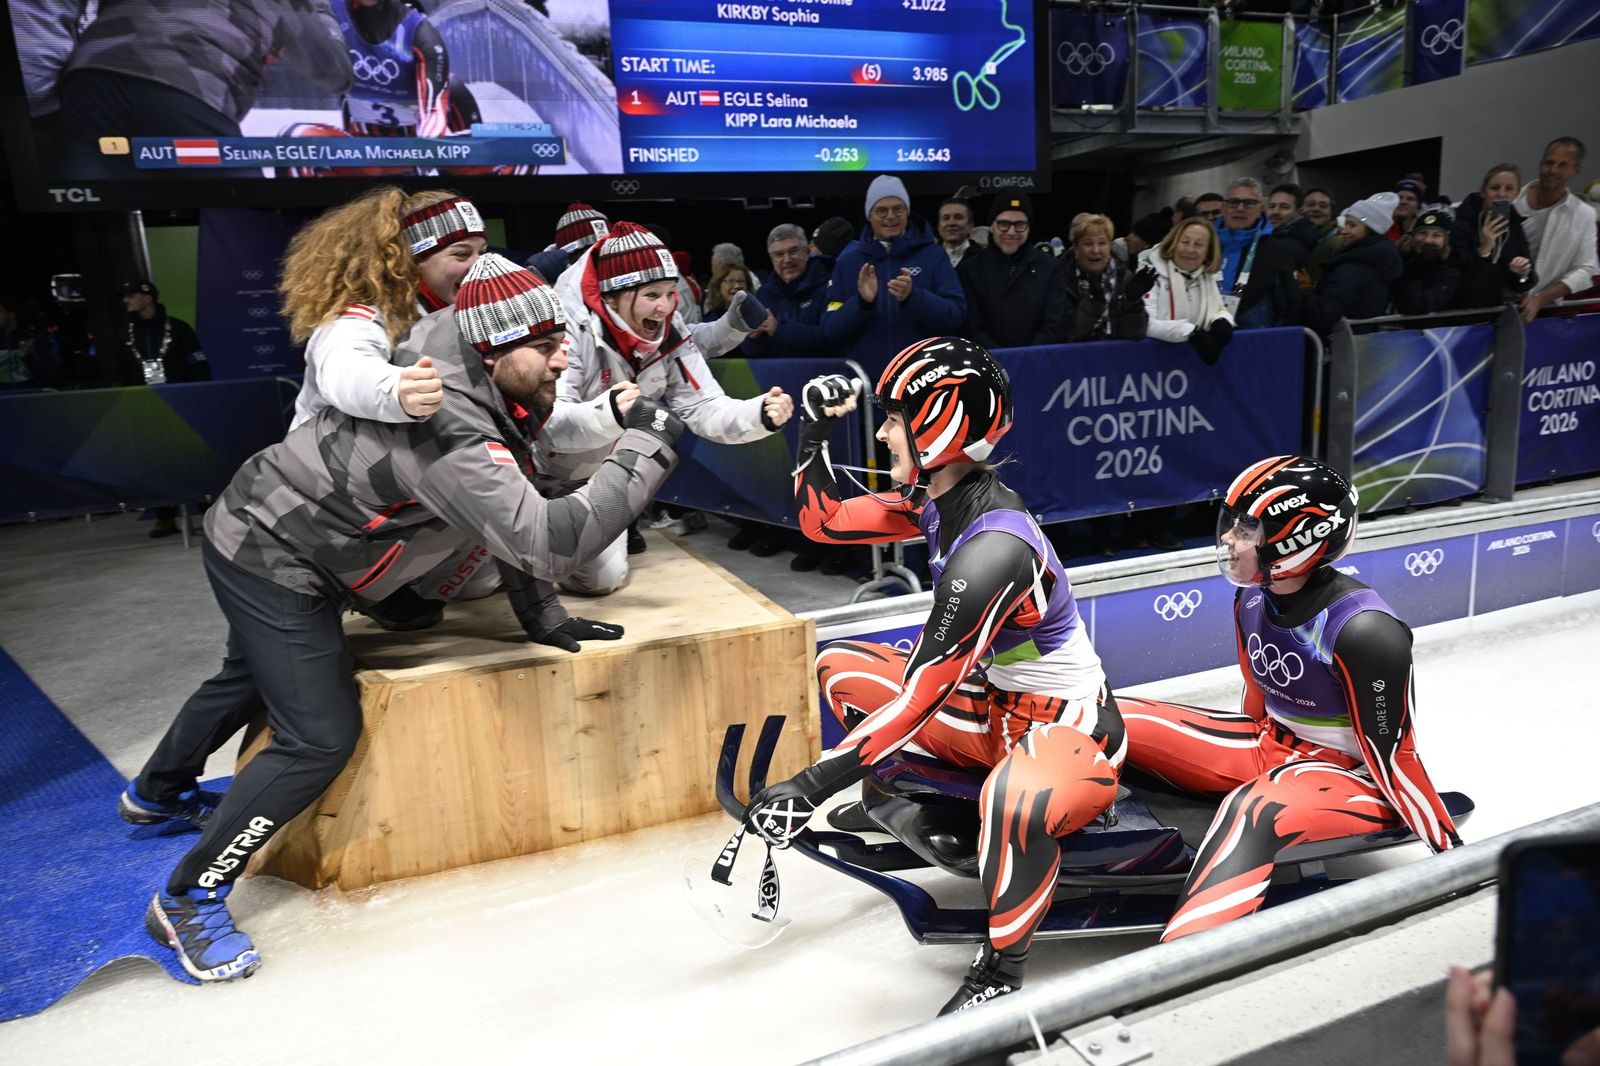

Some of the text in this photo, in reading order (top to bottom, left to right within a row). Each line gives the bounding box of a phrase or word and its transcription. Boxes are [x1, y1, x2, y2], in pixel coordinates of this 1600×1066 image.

[717, 3, 820, 26] KIRKBY Sophia
[1219, 46, 1265, 58] MILANO
[621, 56, 716, 74] START TIME:
[861, 62, 882, 81] (5)
[1225, 59, 1273, 72] CORTINA
[912, 66, 949, 82] 3.985
[1234, 72, 1257, 84] 2026
[631, 90, 642, 105] 1
[665, 91, 809, 108] AUT EGLE Selina
[725, 113, 858, 129] KIPP Lara Michaela
[140, 146, 174, 160] AUT
[436, 145, 471, 160] KIPP
[629, 147, 700, 163] FINISHED
[814, 148, 859, 163] -0.253
[896, 148, 951, 163] 1:46.543
[992, 175, 1036, 188] OMEGA
[48, 187, 101, 203] TCL
[906, 365, 948, 395] uvex
[1521, 360, 1596, 388] MILANO
[1041, 369, 1188, 412] MILANO
[1528, 384, 1600, 412] CORTINA
[1067, 405, 1215, 446] CORTINA
[1540, 411, 1579, 435] 2026
[1095, 445, 1163, 480] 2026
[1267, 493, 1311, 516] uvex
[1275, 509, 1347, 555] uvex
[1295, 698, 1317, 707] 2026
[198, 816, 274, 888] AUSTRIA
